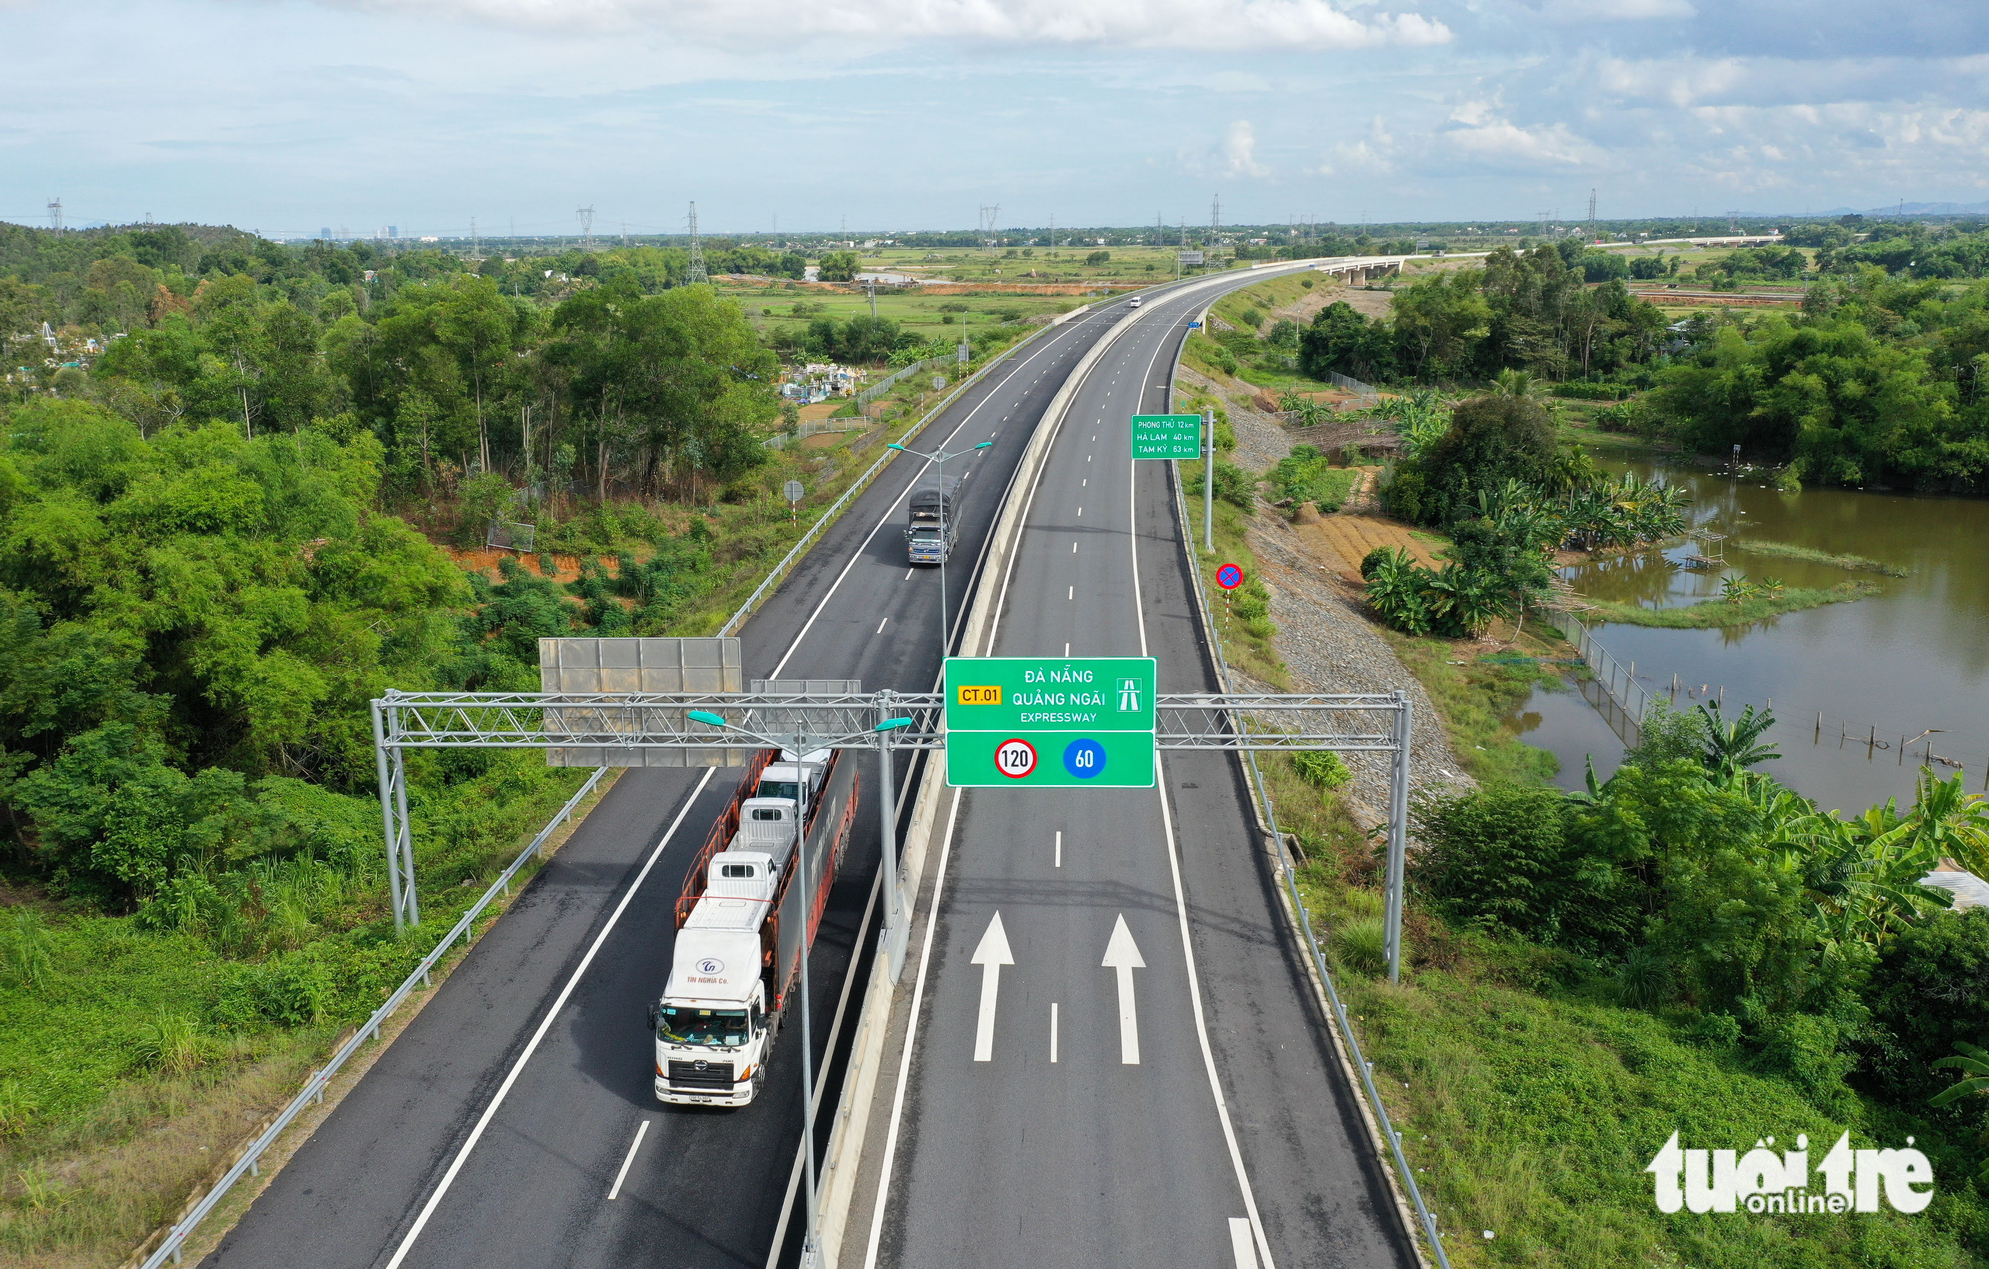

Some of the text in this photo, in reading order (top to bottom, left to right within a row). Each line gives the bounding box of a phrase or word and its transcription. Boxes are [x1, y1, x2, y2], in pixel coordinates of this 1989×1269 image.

[1137, 432, 1148, 441] HÀ
[1024, 664, 1094, 683] ĐÀ NẴNG
[962, 688, 998, 702] CT.01
[1012, 688, 1106, 706] QUẢNG NGÃI
[1020, 712, 1097, 723] EXPRESSWAY
[1002, 749, 1029, 768] 120
[1075, 749, 1094, 768] 60
